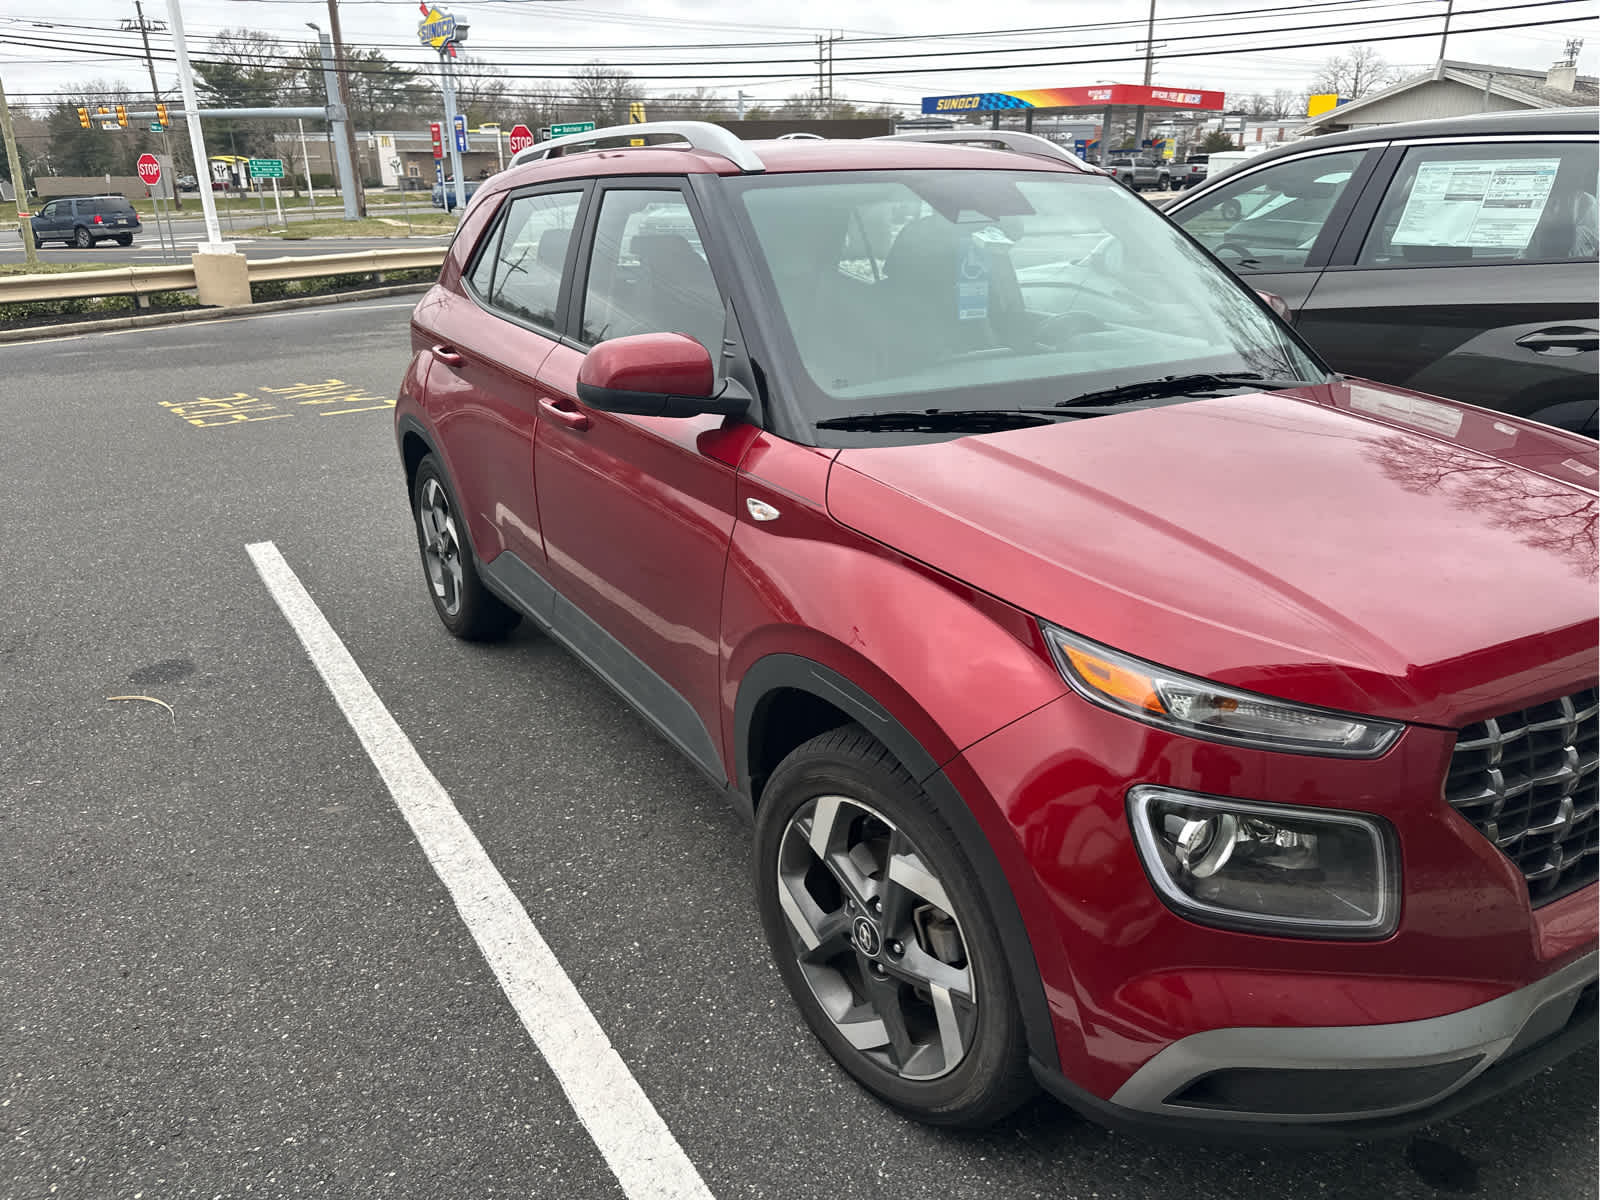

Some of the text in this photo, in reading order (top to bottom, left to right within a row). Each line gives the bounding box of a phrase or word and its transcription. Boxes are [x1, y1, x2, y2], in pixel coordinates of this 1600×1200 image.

[421, 19, 452, 41] SUNOCO
[936, 96, 980, 111] SUNOCO
[511, 136, 532, 151] STOP
[139, 163, 159, 176] STOP
[158, 379, 397, 427] FIRE LANE
